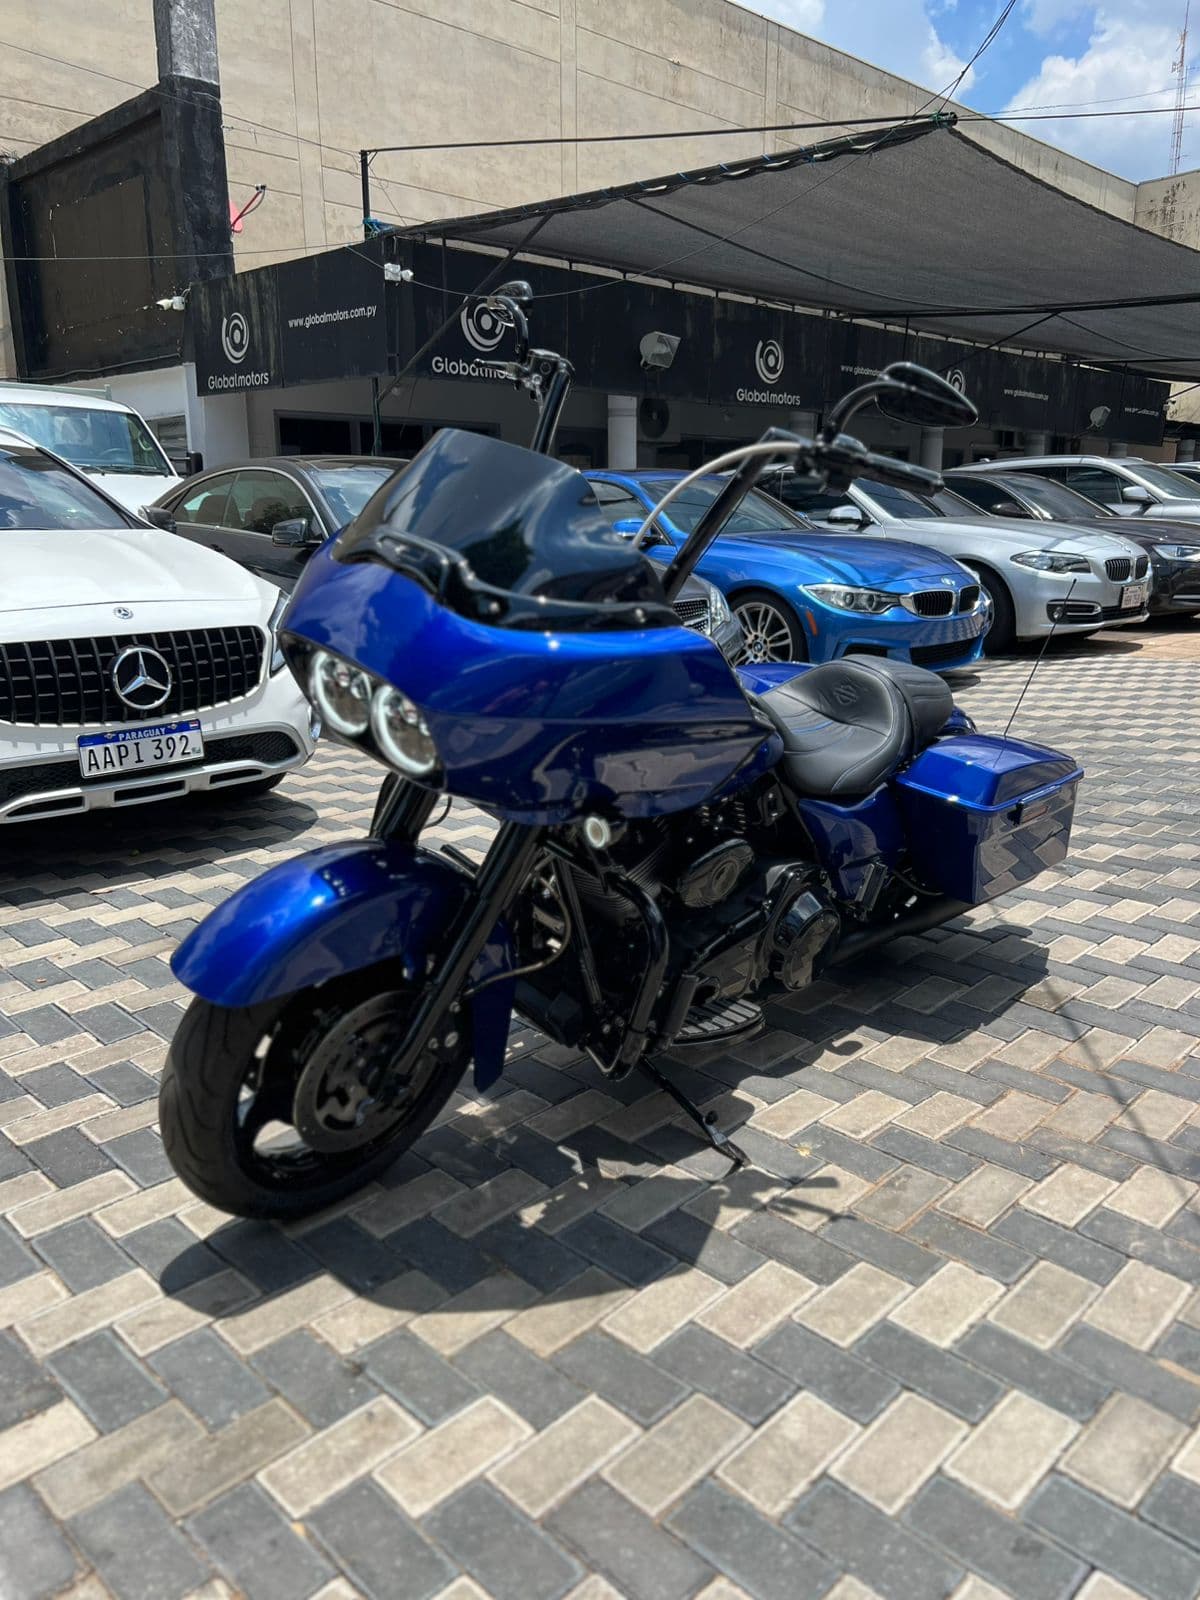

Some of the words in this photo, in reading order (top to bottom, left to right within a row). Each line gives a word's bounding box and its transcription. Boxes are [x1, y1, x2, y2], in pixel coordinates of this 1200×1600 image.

[288, 305, 377, 328] www.globalmotors.com.py
[208, 371, 269, 390] Globalmotors
[736, 388, 801, 406] Globalmotors
[118, 727, 166, 741] PARAGUAY
[88, 742, 144, 771] AAPI
[151, 735, 191, 760] 392
